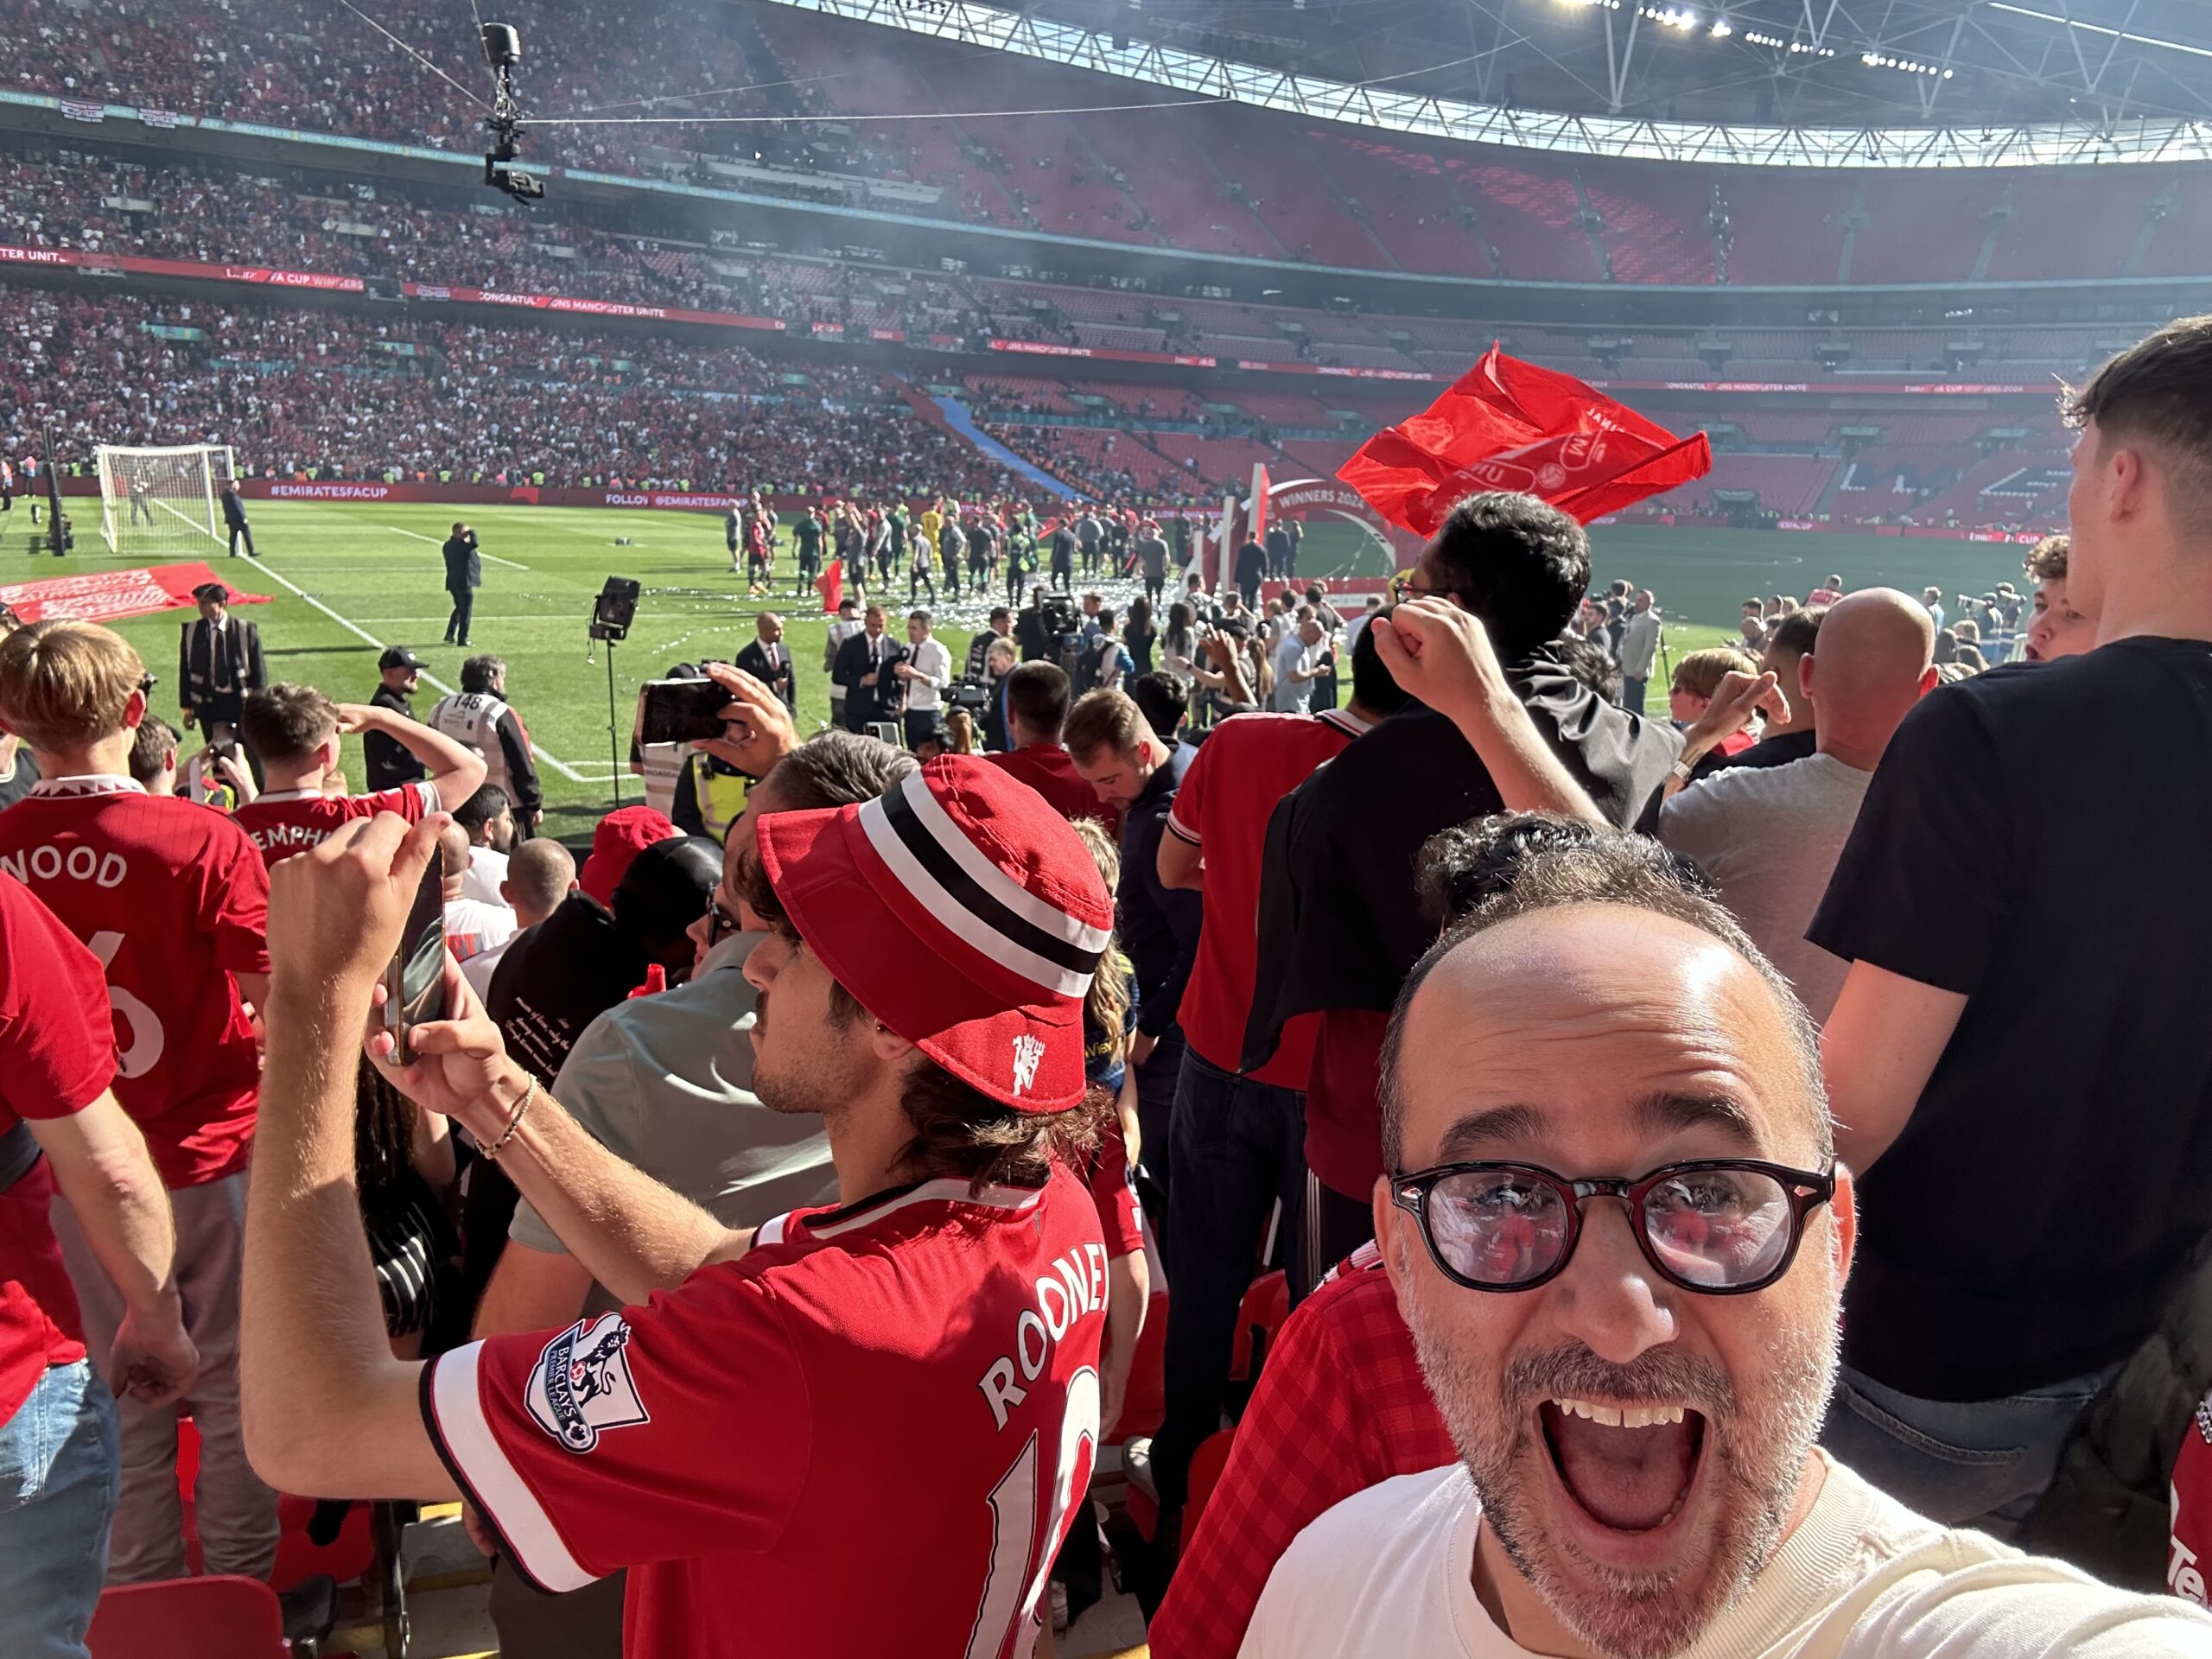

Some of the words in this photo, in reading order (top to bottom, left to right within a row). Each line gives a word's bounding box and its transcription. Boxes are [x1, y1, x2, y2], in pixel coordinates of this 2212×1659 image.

[287, 274, 311, 283] CUP
[270, 486, 388, 498] #EMIRATESFACUP
[655, 495, 747, 508] @EMIRATESFAP
[1279, 488, 1335, 508] WINNERS
[1337, 492, 1365, 510] 2024
[2018, 534, 2039, 544] CUP
[546, 1350, 557, 1384] PREMIER
[554, 1346, 577, 1417] BARCLAYS
[548, 1386, 566, 1421] LEAGUE
[2167, 1534, 2208, 1601] Te
